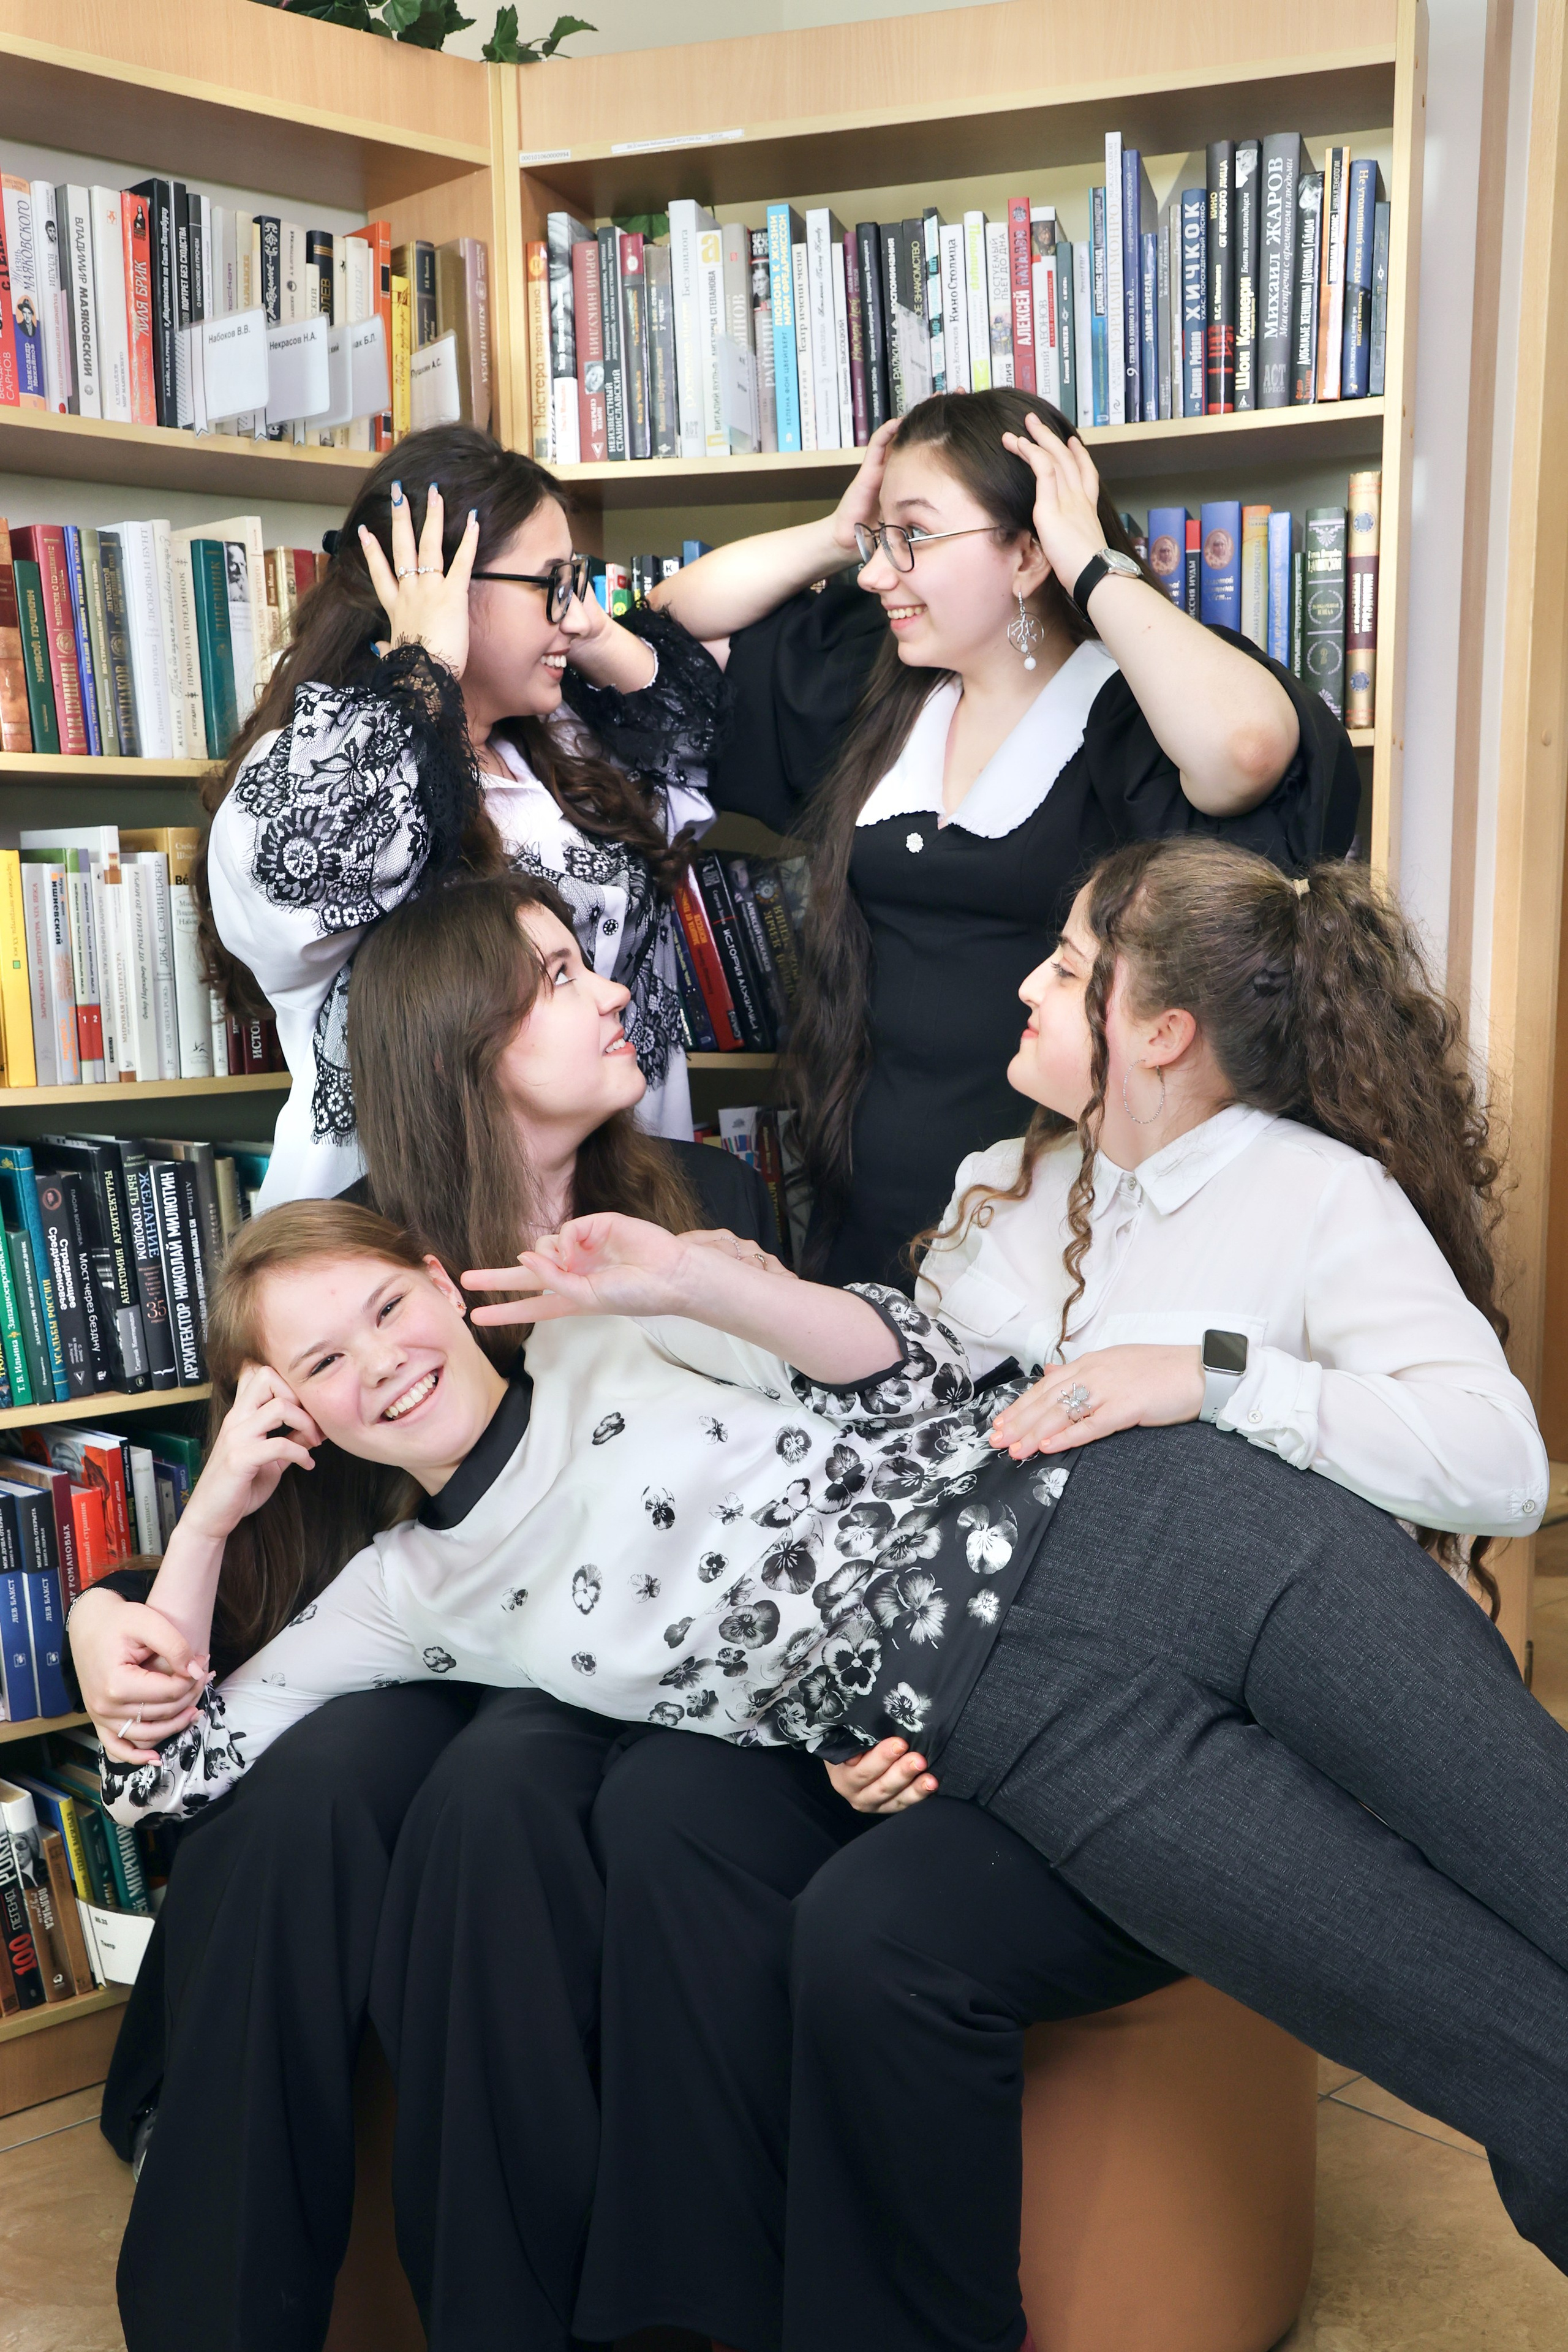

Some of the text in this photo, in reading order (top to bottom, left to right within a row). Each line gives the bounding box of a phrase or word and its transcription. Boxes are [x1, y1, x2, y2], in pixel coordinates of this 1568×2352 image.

[1219, 160, 1228, 247] ОТ ПЕРВОГО ЛИЦА
[1330, 214, 1340, 243] ДЖОНС
[1353, 169, 1369, 284] Не утоливший жажды
[17, 200, 35, 292] МАЯКОВСКОГО
[969, 224, 982, 291] Пельтцер
[1240, 192, 1251, 273] Быть шотландцем
[1264, 157, 1283, 339] Михаил ЖАРОВ
[1279, 157, 1294, 338] Мои встречи временем людьми
[47, 253, 56, 286] ВЛАДИ
[179, 227, 189, 311] ПОРТРЕТ БЕЗ СХОДСТВА
[679, 229, 692, 296] Без эпилога
[769, 215, 783, 326] ЛЮБОВЬ К ЖИЗНИ
[778, 214, 793, 325] МАРИ ФРЕДРИКССОН
[911, 241, 922, 303] ЗНАКОМСТВО
[991, 233, 1009, 301] ТОСТУЕМЫЙ ПЬЕТ ДО ДНА
[1093, 248, 1104, 274] БОНД
[1108, 204, 1121, 351] МЭРИЛИН МОНРО
[1184, 201, 1200, 321] ХИЧКОК
[75, 217, 92, 376] ВЛАДИМИР МАЯКОВСКИЙ
[133, 260, 149, 336] ЛИЛЯ БРИК
[586, 249, 600, 356] ЮРИЙ НИКУЛИН
[707, 271, 717, 315] СТЕПАНОВА
[797, 283, 805, 322] имени
[888, 238, 902, 380] РАЙКИН воспоминания
[1013, 230, 1032, 346] АЛЕКСЕЙ БАТАЛОВ
[1093, 275, 1104, 314] ДЖЕЙМС
[1144, 273, 1153, 311] ПРЕСЛИ
[1235, 277, 1254, 346] Коннери
[208, 325, 251, 344] Набоков В.В.
[269, 332, 317, 351] Некрасов Н.А.
[797, 324, 808, 355] Театр
[838, 319, 848, 364] ВЫСОЦКИЙ
[1038, 300, 1052, 394] Евгений ЛЕОНОВ
[1128, 345, 1136, 364] глав
[3, 352, 15, 400] САРНОВ
[24, 342, 34, 391] Александр
[411, 364, 431, 378] Пушкин
[532, 325, 548, 428] Мастера театра
[1127, 368, 1139, 377] 9
[1189, 331, 1203, 399] Стивен Ребелло
[1235, 350, 1251, 390] Шон
[1264, 363, 1287, 387] АСТ
[604, 369, 624, 453] НЕИЗВЕСТНЫЙ СТАНИСЛАВСКИЙ
[710, 391, 722, 431] ВИТАЛИЙ
[48, 545, 59, 584] ПУШКИНЕ
[77, 573, 85, 606] ПУШКИН
[140, 527, 156, 622] ЛЮБОВЬ И БУНТ
[210, 561, 226, 631] ДНЕВНИК
[27, 589, 45, 683] ЖИВОЙ ПУШКИН
[97, 622, 107, 666] СТРАНИЦАМ
[178, 573, 195, 685] ПРАВО НА ПОЕДИНОК
[83, 642, 92, 674] ВАСИЛИЙ
[152, 667, 160, 687] 1910
[1320, 647, 1328, 665] 2
[60, 662, 80, 715] ПУЩИН
[155, 690, 165, 734] Дневник
[135, 899, 142, 911] ДО
[153, 861, 166, 932] СЭЛИНДЖЕР
[745, 902, 762, 937] АЛЕКСЕЙ
[34, 921, 44, 967] ЛИТЕРАТУРА
[135, 913, 145, 951] РОЛЛАНА
[138, 952, 145, 962] ОТ
[37, 970, 48, 1019] ЗАРУБЕЖНАЯ
[116, 952, 128, 1043] МИРОВАЯ ЛИТЕРАТУРА
[723, 929, 758, 1030] ИСТОРИЯ АЛХИМИИ
[127, 1174, 140, 1205] БЫТЬ
[138, 1171, 160, 1258] ЖЕЛАНИЕ
[104, 1170, 130, 1305] АНАТОМИЯ АРХИТЕКТУРЫ
[131, 1207, 148, 1261] ГОРОДОМ
[48, 1226, 67, 1310] Средневековье
[59, 1238, 77, 1308] Страдающее
[160, 1172, 200, 1380] АРХИТЕКТОР НИКОЛАЙ МИЛЮТИН
[42, 1279, 64, 1365] УСАДЬБЫ РОССИИ
[78, 1253, 101, 1352] Мост через бездну
[146, 1301, 167, 1319] 35
[12, 1340, 26, 1393] Т. В. Ильина
[133, 1349, 142, 1371] Сергей
[31, 1507, 39, 1536] ОТКРЫТА
[80, 1502, 89, 1540] странник
[62, 1523, 75, 1588] РОМАНОВЫХ
[8, 1579, 17, 1605] БАКСТ
[42, 1578, 51, 1604] БАКСТ
[4, 1888, 37, 1975] 100 ЛЕГЕНД
[37, 1887, 55, 1930] ПОЛЧАСА
